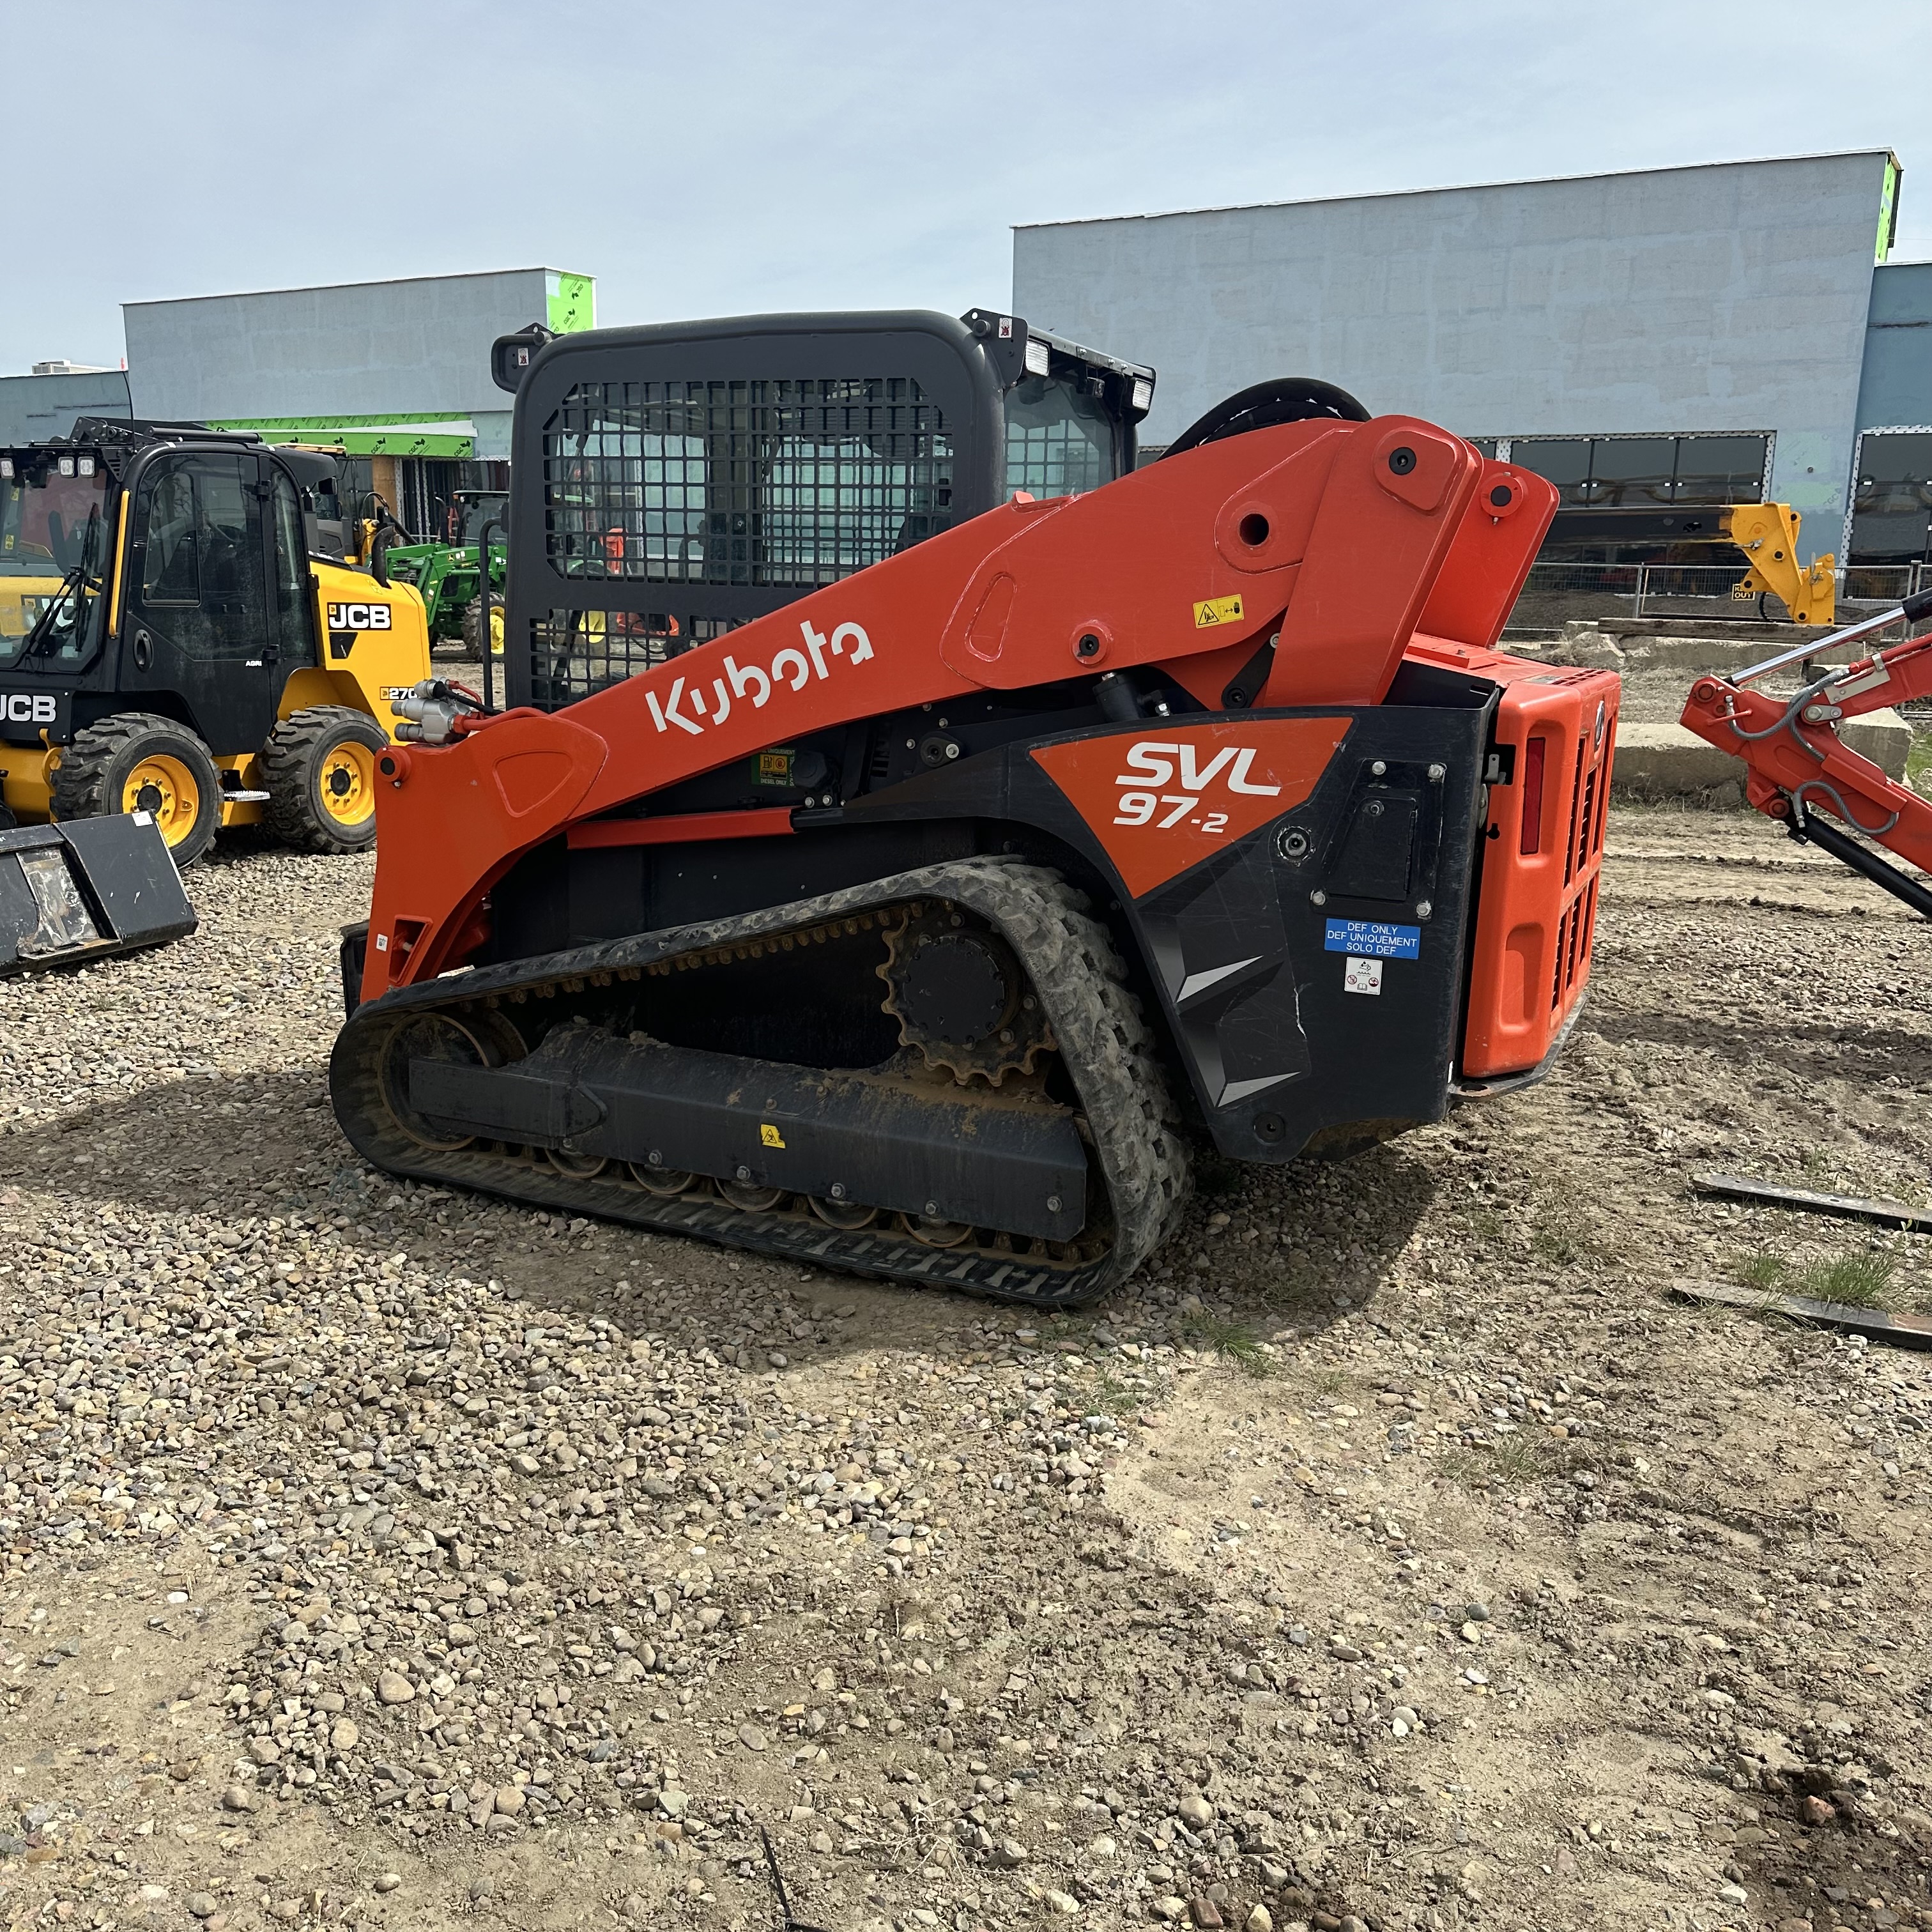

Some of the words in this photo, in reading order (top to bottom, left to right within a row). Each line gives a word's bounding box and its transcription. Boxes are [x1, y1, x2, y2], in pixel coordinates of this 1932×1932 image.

[371, 444, 381, 454] CGC
[408, 445, 418, 455] CGC
[454, 447, 464, 457] CGC
[329, 604, 391, 629] JCB
[645, 620, 875, 735] Kubota
[389, 687, 418, 700] 270
[1115, 742, 1281, 796] SVL
[1112, 792, 1229, 834] 97-2
[1347, 922, 1368, 932] DEF
[1371, 925, 1399, 935] ONLY
[1327, 930, 1347, 940] DEF
[1350, 933, 1418, 947] UNIQUEMENT
[1346, 942, 1373, 953] SOLO
[1376, 946, 1397, 955] DEF
